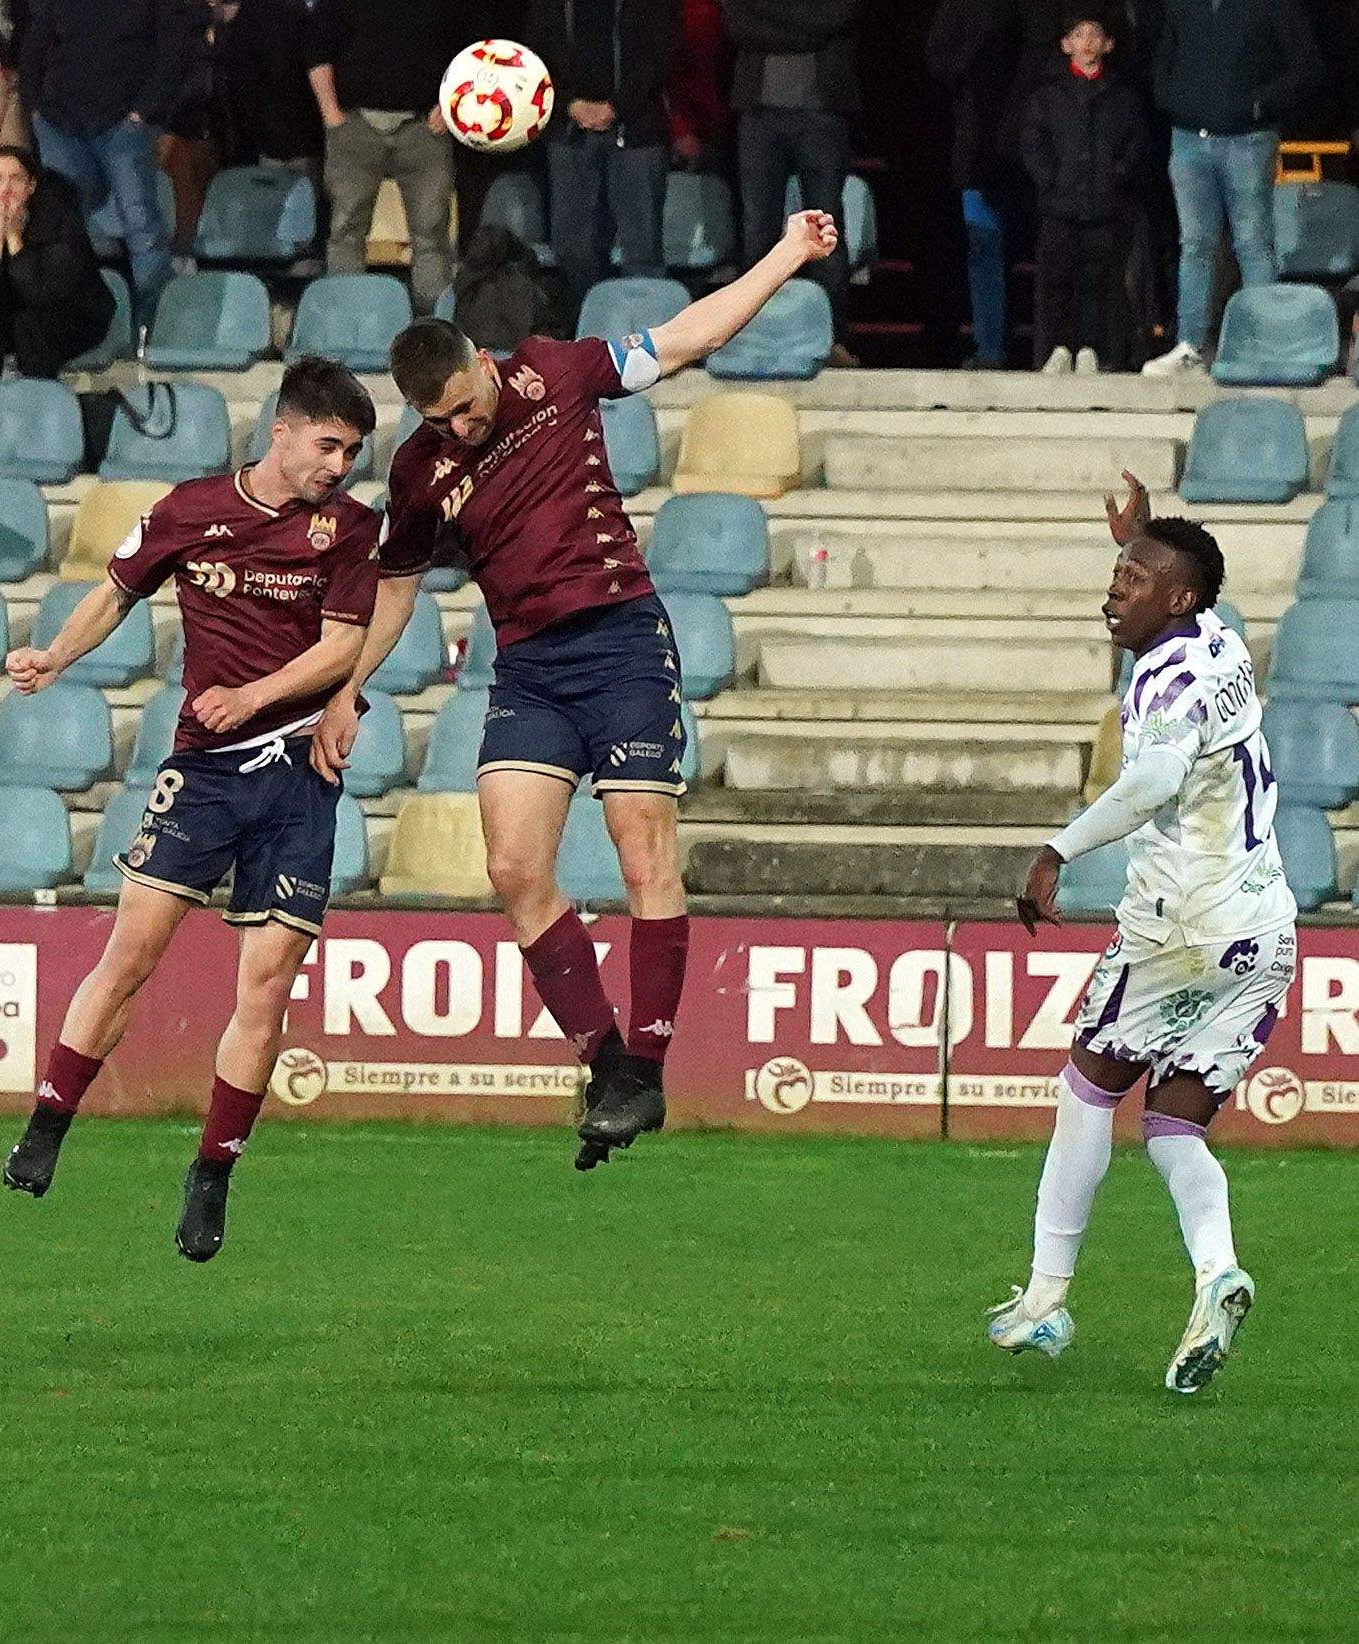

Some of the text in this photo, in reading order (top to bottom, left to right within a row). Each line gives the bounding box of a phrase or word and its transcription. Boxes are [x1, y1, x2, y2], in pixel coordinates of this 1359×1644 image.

[148, 768, 185, 813] 8
[748, 946, 1102, 1050] FROIZ
[344, 1066, 440, 1089] Siempre
[449, 1073, 462, 1086] a
[469, 1074, 495, 1087] su
[831, 1075, 927, 1100] Siempre
[959, 1082, 984, 1097] su
